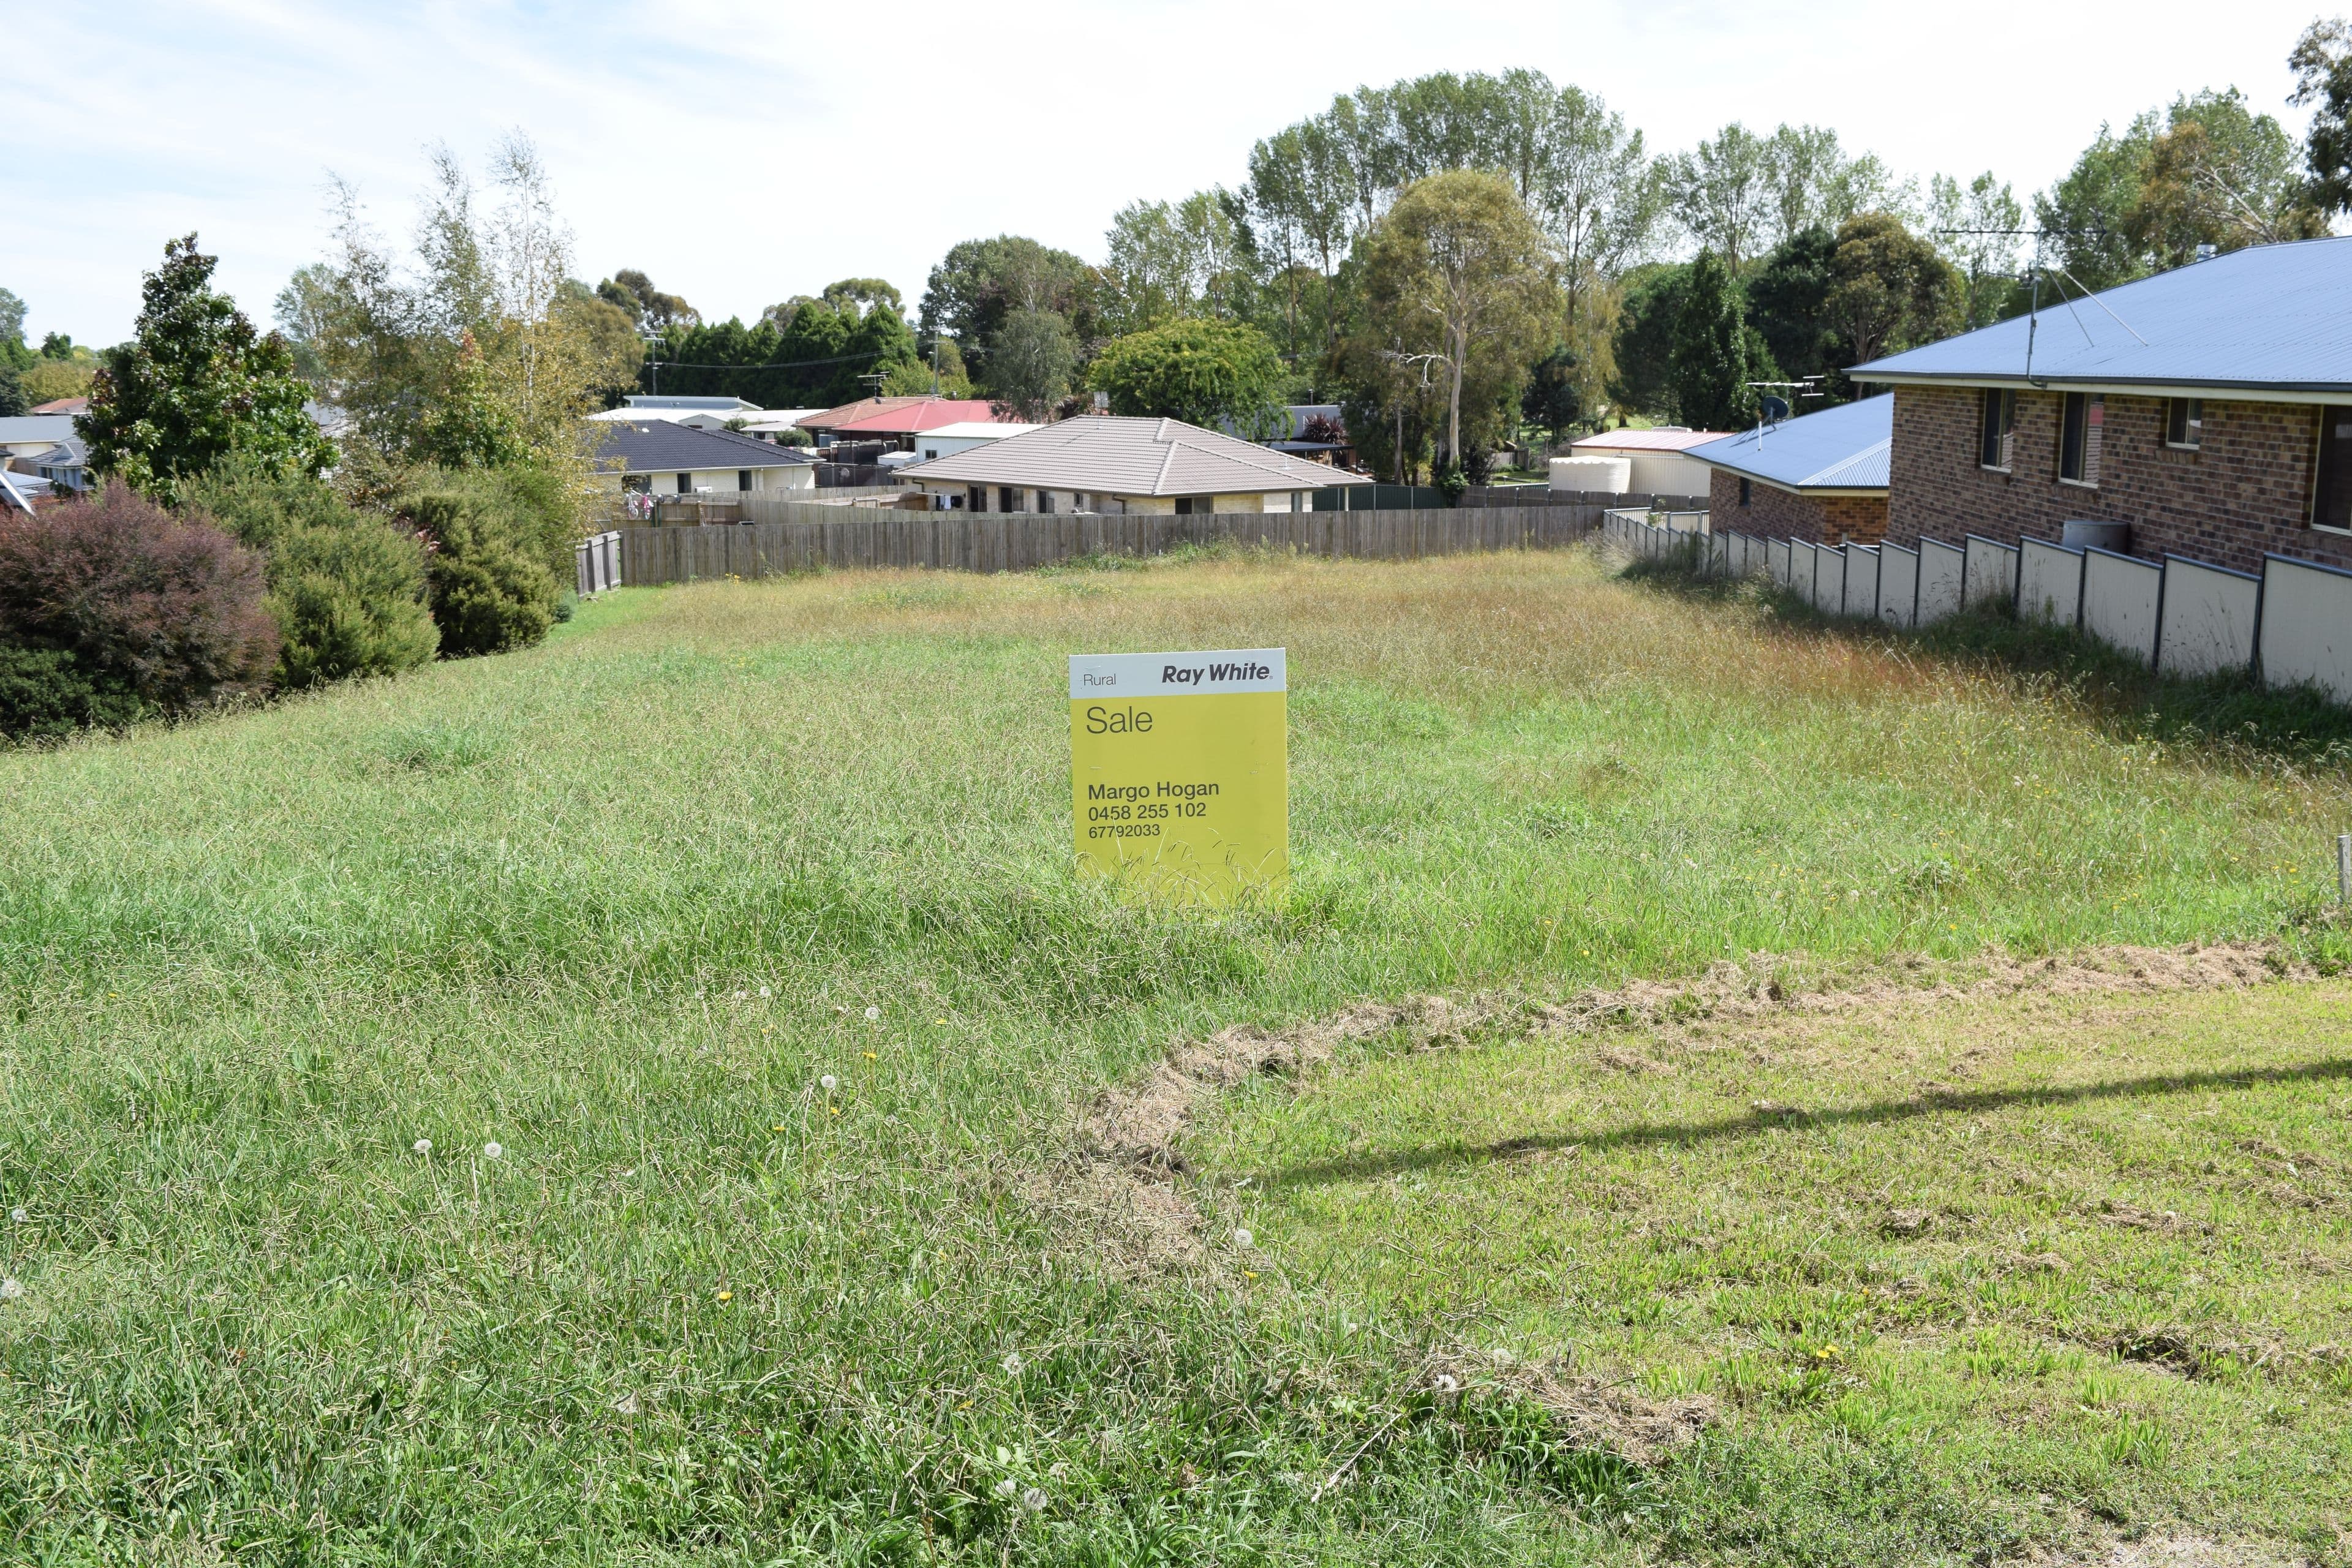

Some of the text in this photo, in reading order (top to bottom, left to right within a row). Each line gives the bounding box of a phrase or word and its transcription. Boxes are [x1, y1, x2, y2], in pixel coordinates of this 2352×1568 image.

[1084, 673, 1116, 686] Rural
[1161, 665, 1205, 686] Ray
[1086, 706, 1153, 734] Sale
[1088, 781, 1219, 802] Margo Hogan
[1088, 802, 1207, 821] 0458 255 102
[1088, 823, 1161, 839] 67792033
